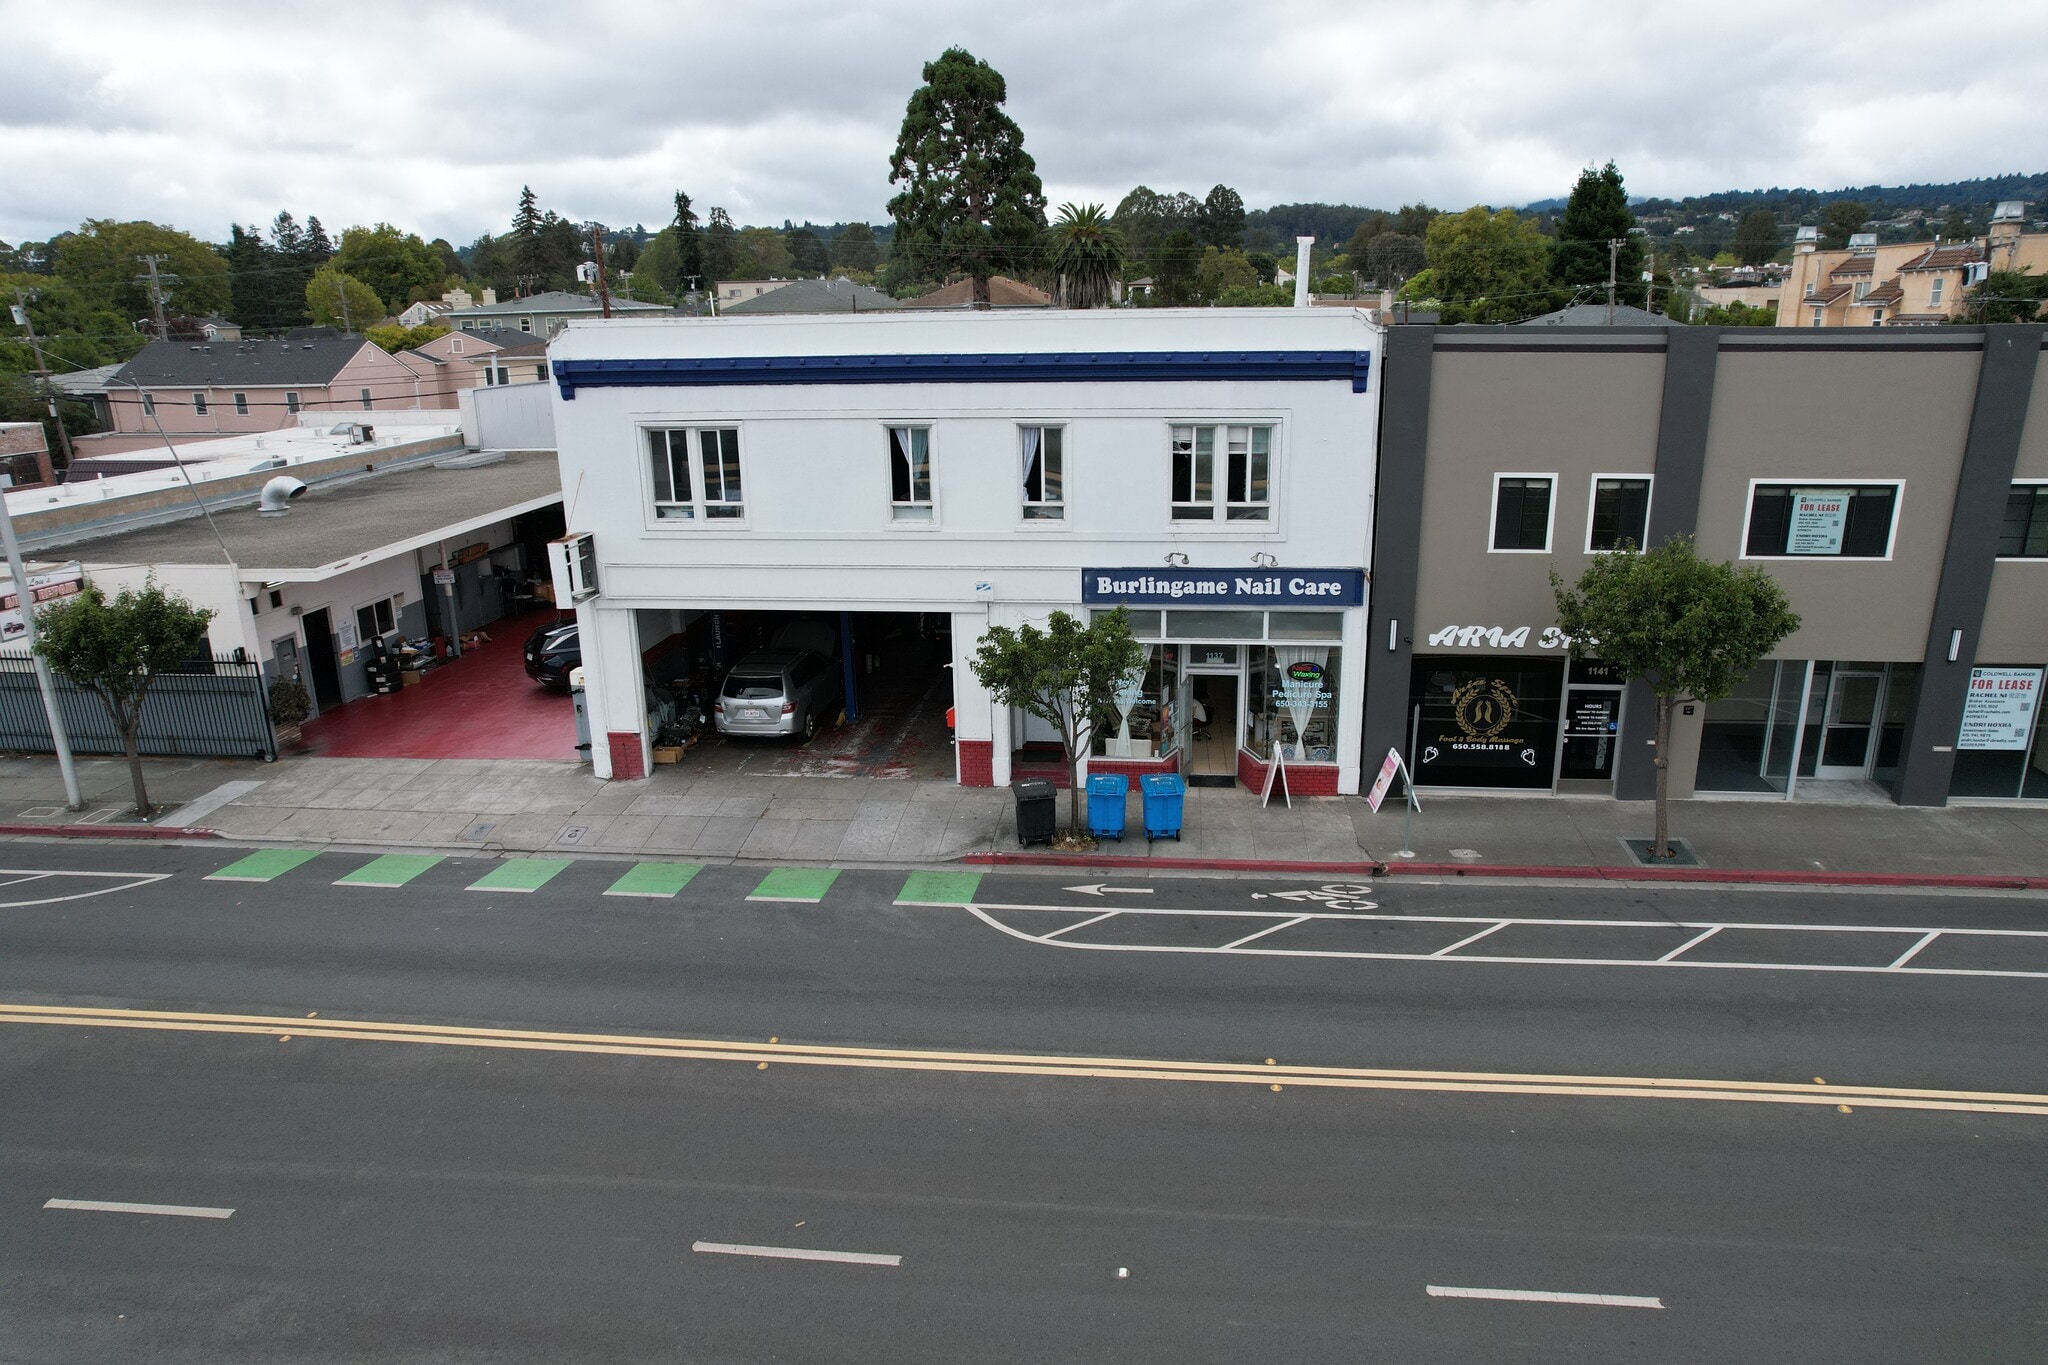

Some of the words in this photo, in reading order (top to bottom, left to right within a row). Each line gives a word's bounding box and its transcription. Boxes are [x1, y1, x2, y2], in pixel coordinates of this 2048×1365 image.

[1097, 577, 1228, 598] Burlingame
[1234, 577, 1282, 596] Nail
[1288, 578, 1342, 596] Care
[5, 591, 36, 609] AUO
[37, 582, 78, 600] REPAIR
[713, 614, 721, 645] LAUNCH
[1429, 625, 1531, 648] ARIA
[1293, 671, 1320, 679] Waxing
[1588, 667, 1609, 675] 1141
[1282, 680, 1323, 688] Manicure
[1971, 680, 1994, 690] FOR
[1998, 680, 2033, 690] LEASE
[1272, 690, 1312, 698] Pedicure
[1315, 690, 1332, 700] Spa
[1438, 734, 1457, 742] Foot
[1489, 736, 1524, 744] Massage
